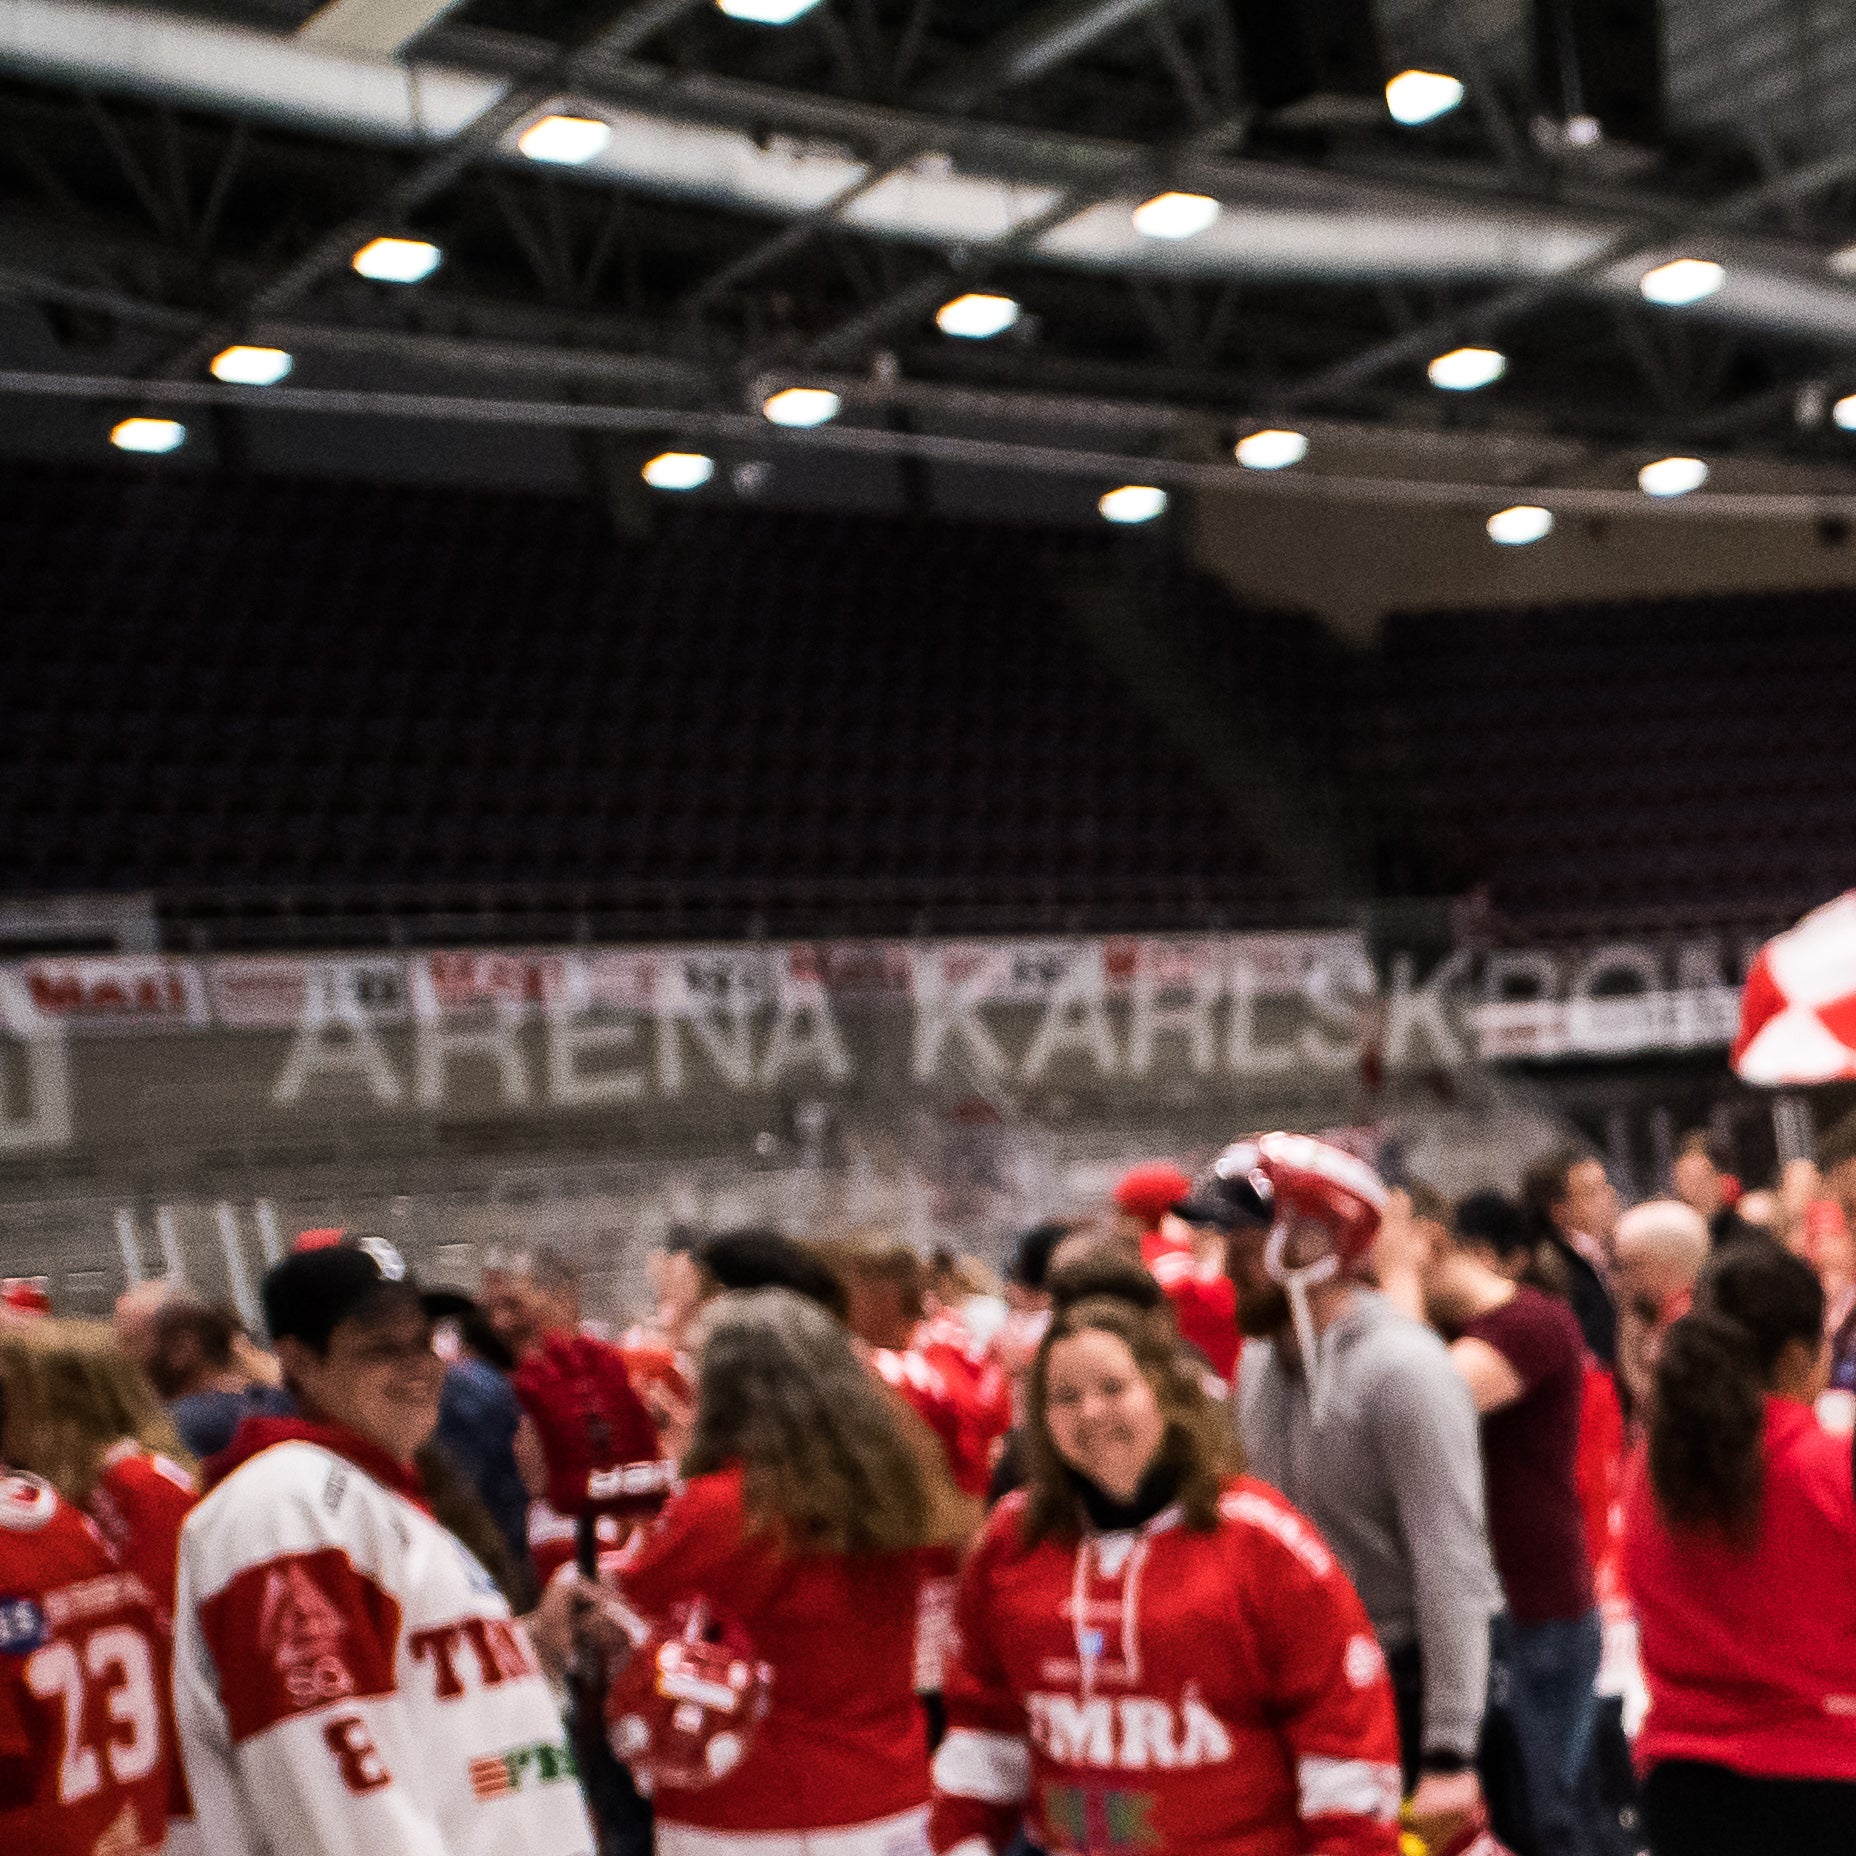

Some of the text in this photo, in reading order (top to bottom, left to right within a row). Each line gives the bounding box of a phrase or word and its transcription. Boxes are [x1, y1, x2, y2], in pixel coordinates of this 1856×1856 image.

[270, 938, 1760, 1106] ARENA KARLSKRON
[25, 1622, 158, 1802] 23
